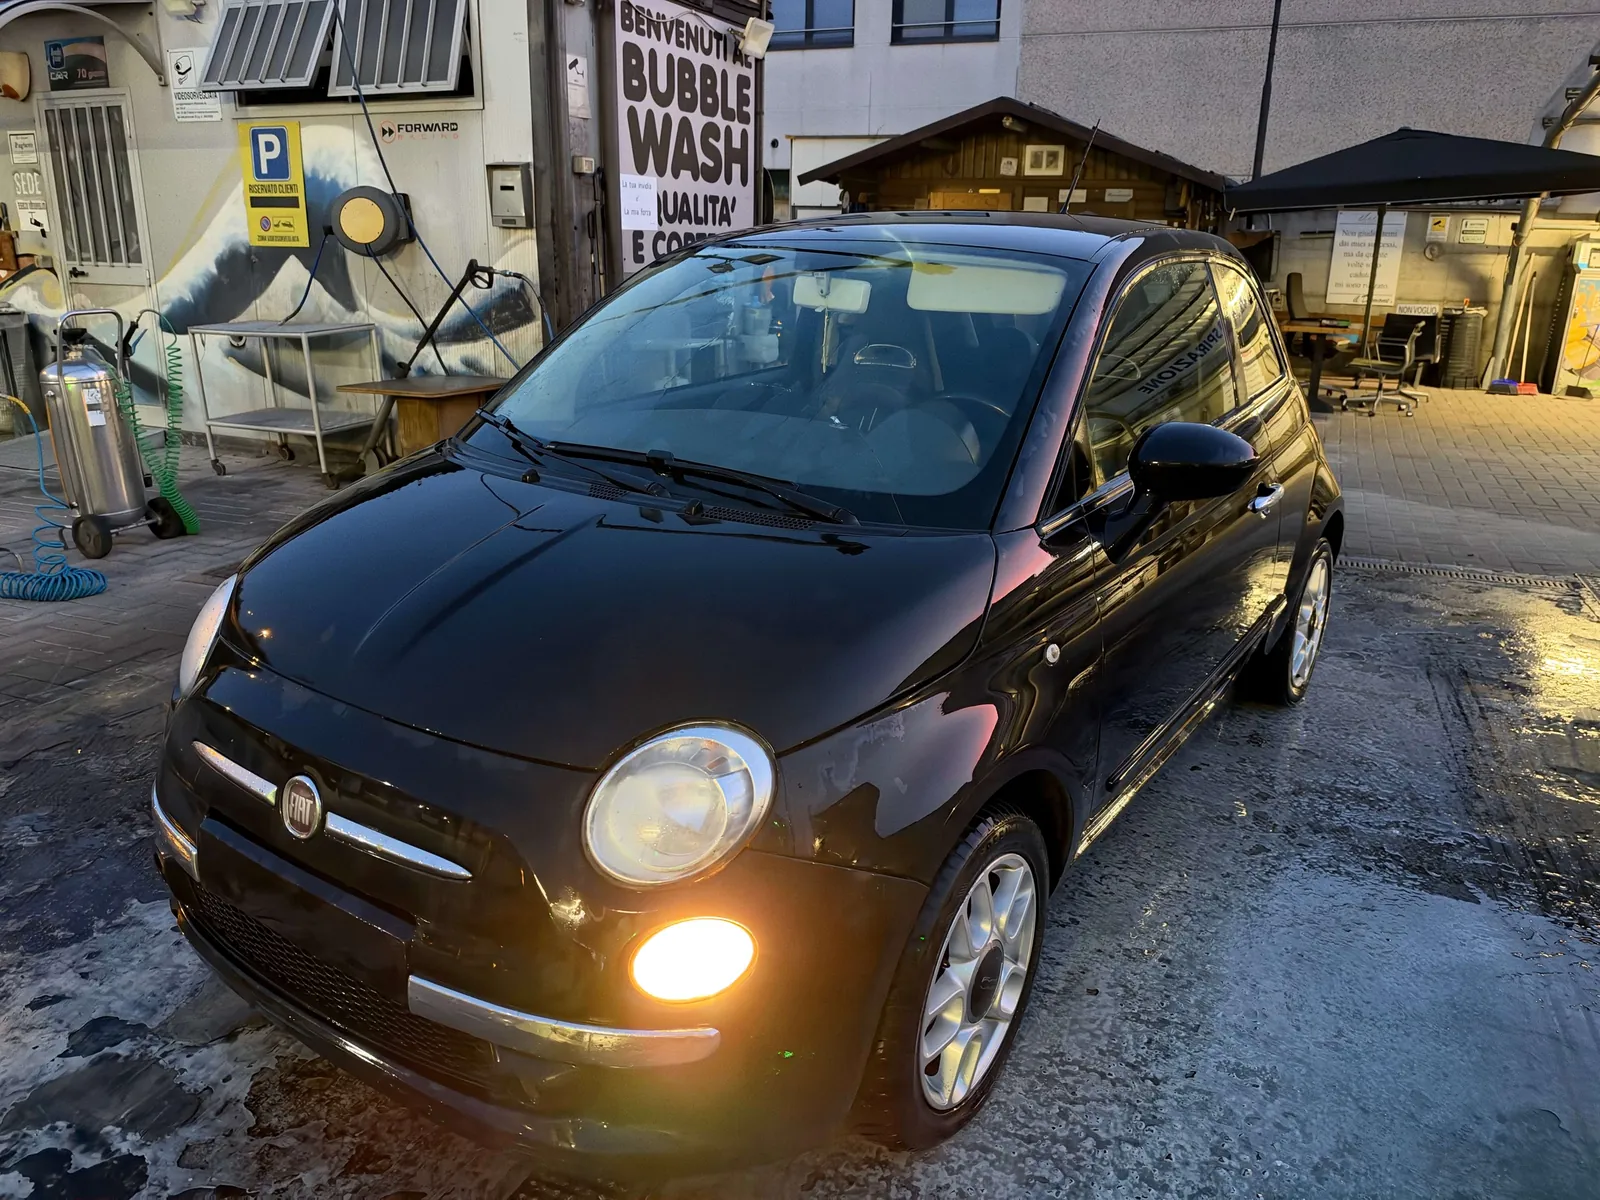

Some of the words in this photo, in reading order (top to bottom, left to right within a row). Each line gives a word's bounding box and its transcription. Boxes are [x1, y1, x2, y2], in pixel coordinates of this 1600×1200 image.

[621, 1, 727, 62] BENVENUTI
[623, 41, 751, 125] BUBBLE
[397, 122, 459, 133] FORWARD
[258, 134, 281, 175] P
[627, 105, 748, 187] WASH
[14, 172, 41, 194] SEDE
[249, 184, 277, 194] RISERVATO
[278, 184, 299, 194] CLIENTI
[633, 230, 645, 264] E
[1398, 305, 1413, 314] NON
[289, 791, 314, 826] FIAT
